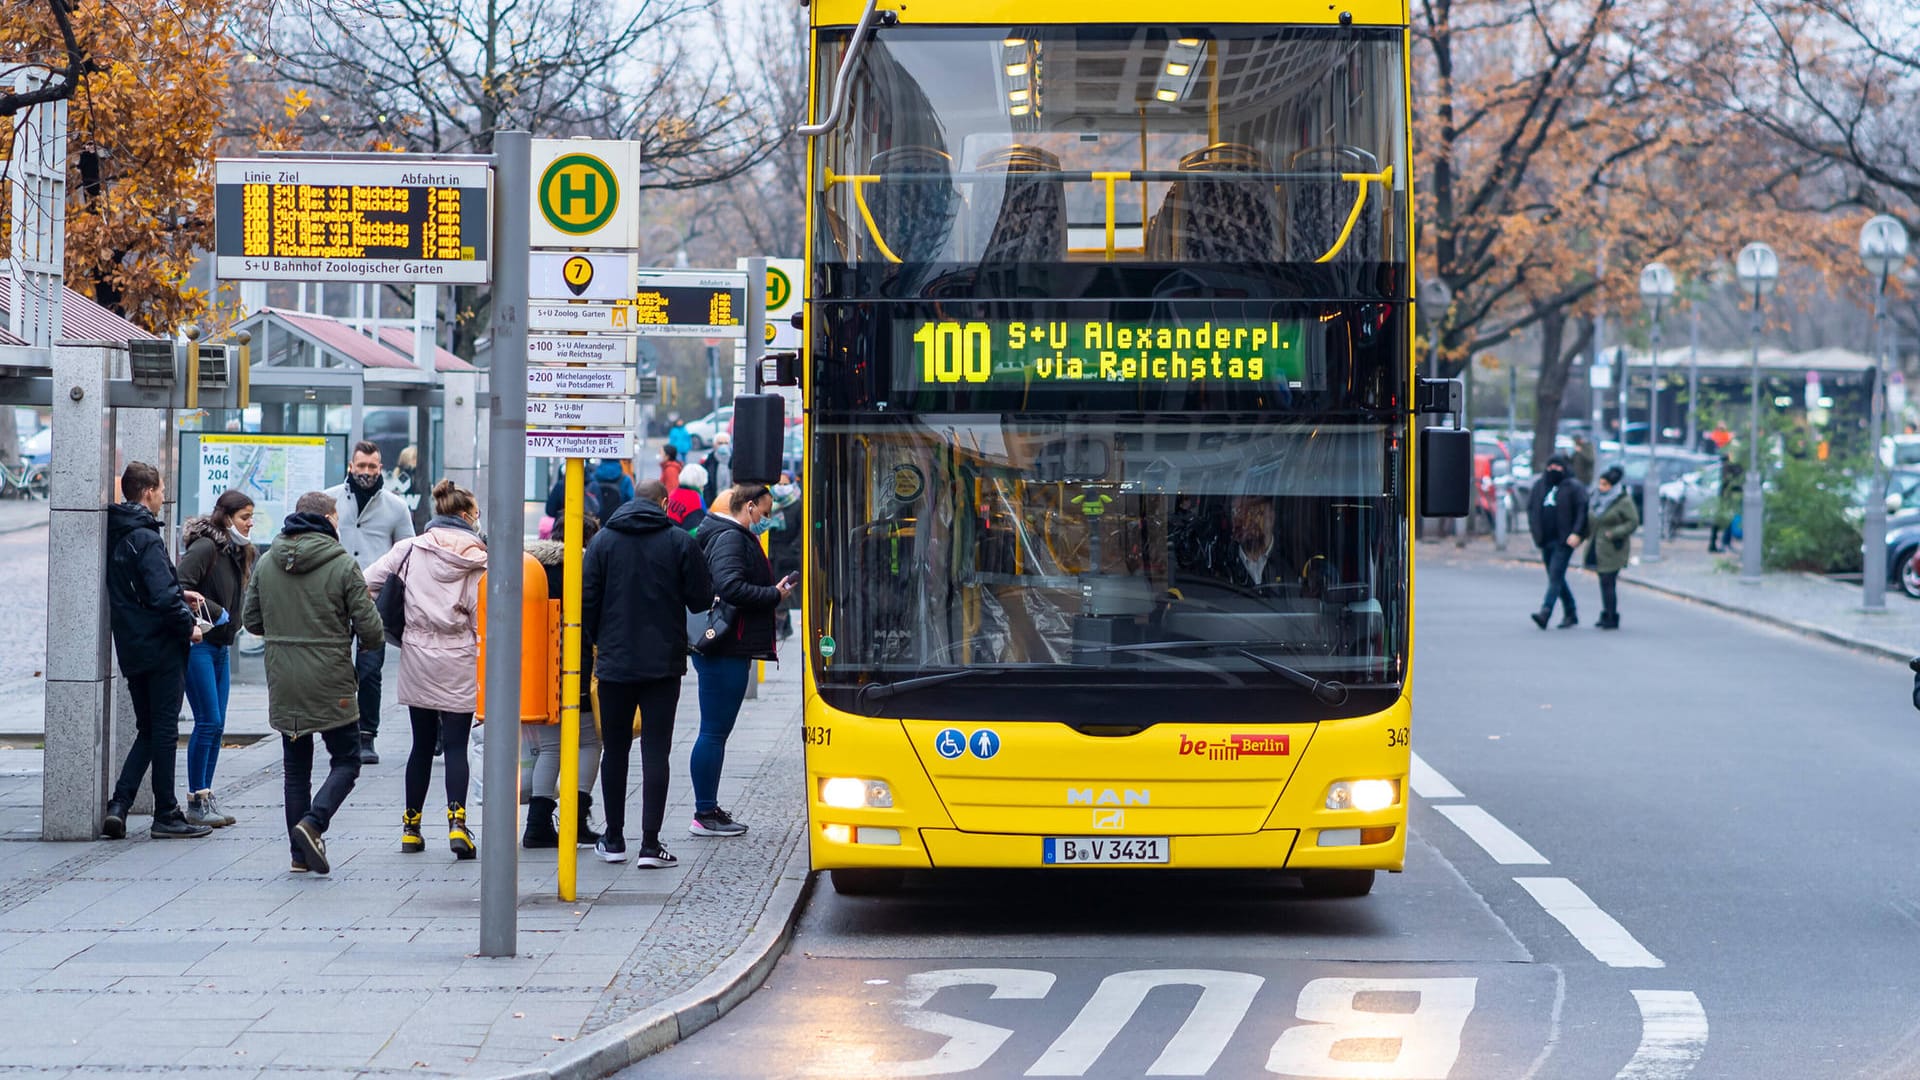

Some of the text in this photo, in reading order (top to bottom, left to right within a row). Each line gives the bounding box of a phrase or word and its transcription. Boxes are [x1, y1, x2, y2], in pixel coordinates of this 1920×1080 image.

[244, 171, 460, 185] Linie Ziel Abfahrt in
[244, 184, 460, 200] 100 S+U Alex via Reichstag 2 min
[560, 174, 596, 215] H
[244, 196, 460, 212] 100 S+U Alex via Reichstag 7 min
[244, 208, 460, 224] 200 Michelangelostr. 7 min
[244, 220, 460, 236] 100 S+U Alex via Reichstag 12 min
[244, 232, 460, 248] 100 S+U Alex via Reichstag 17 min
[244, 244, 460, 259] 200 Michelangelostr. 17 min
[244, 261, 443, 276] S+U Bahnhof Zoologischer Garten
[574, 264, 583, 279] 7
[612, 308, 626, 328] A
[536, 342, 552, 351] 100
[574, 342, 616, 351] Alexanderpl.
[913, 322, 1290, 382] 100 S+U Alexanderpl.
[569, 351, 602, 359] Reichstag
[1036, 352, 1083, 379] via
[1100, 351, 1264, 380] Reichstag
[536, 372, 612, 382] 200 Michelangelostr.
[534, 403, 547, 413] N2
[534, 438, 554, 447] N7X
[563, 438, 598, 446] Flughafen
[204, 454, 230, 466] M46
[208, 470, 228, 480] 204
[1179, 734, 1284, 756] be Berlin
[1066, 788, 1151, 806] MAN
[1064, 840, 1160, 860] B V 3431
